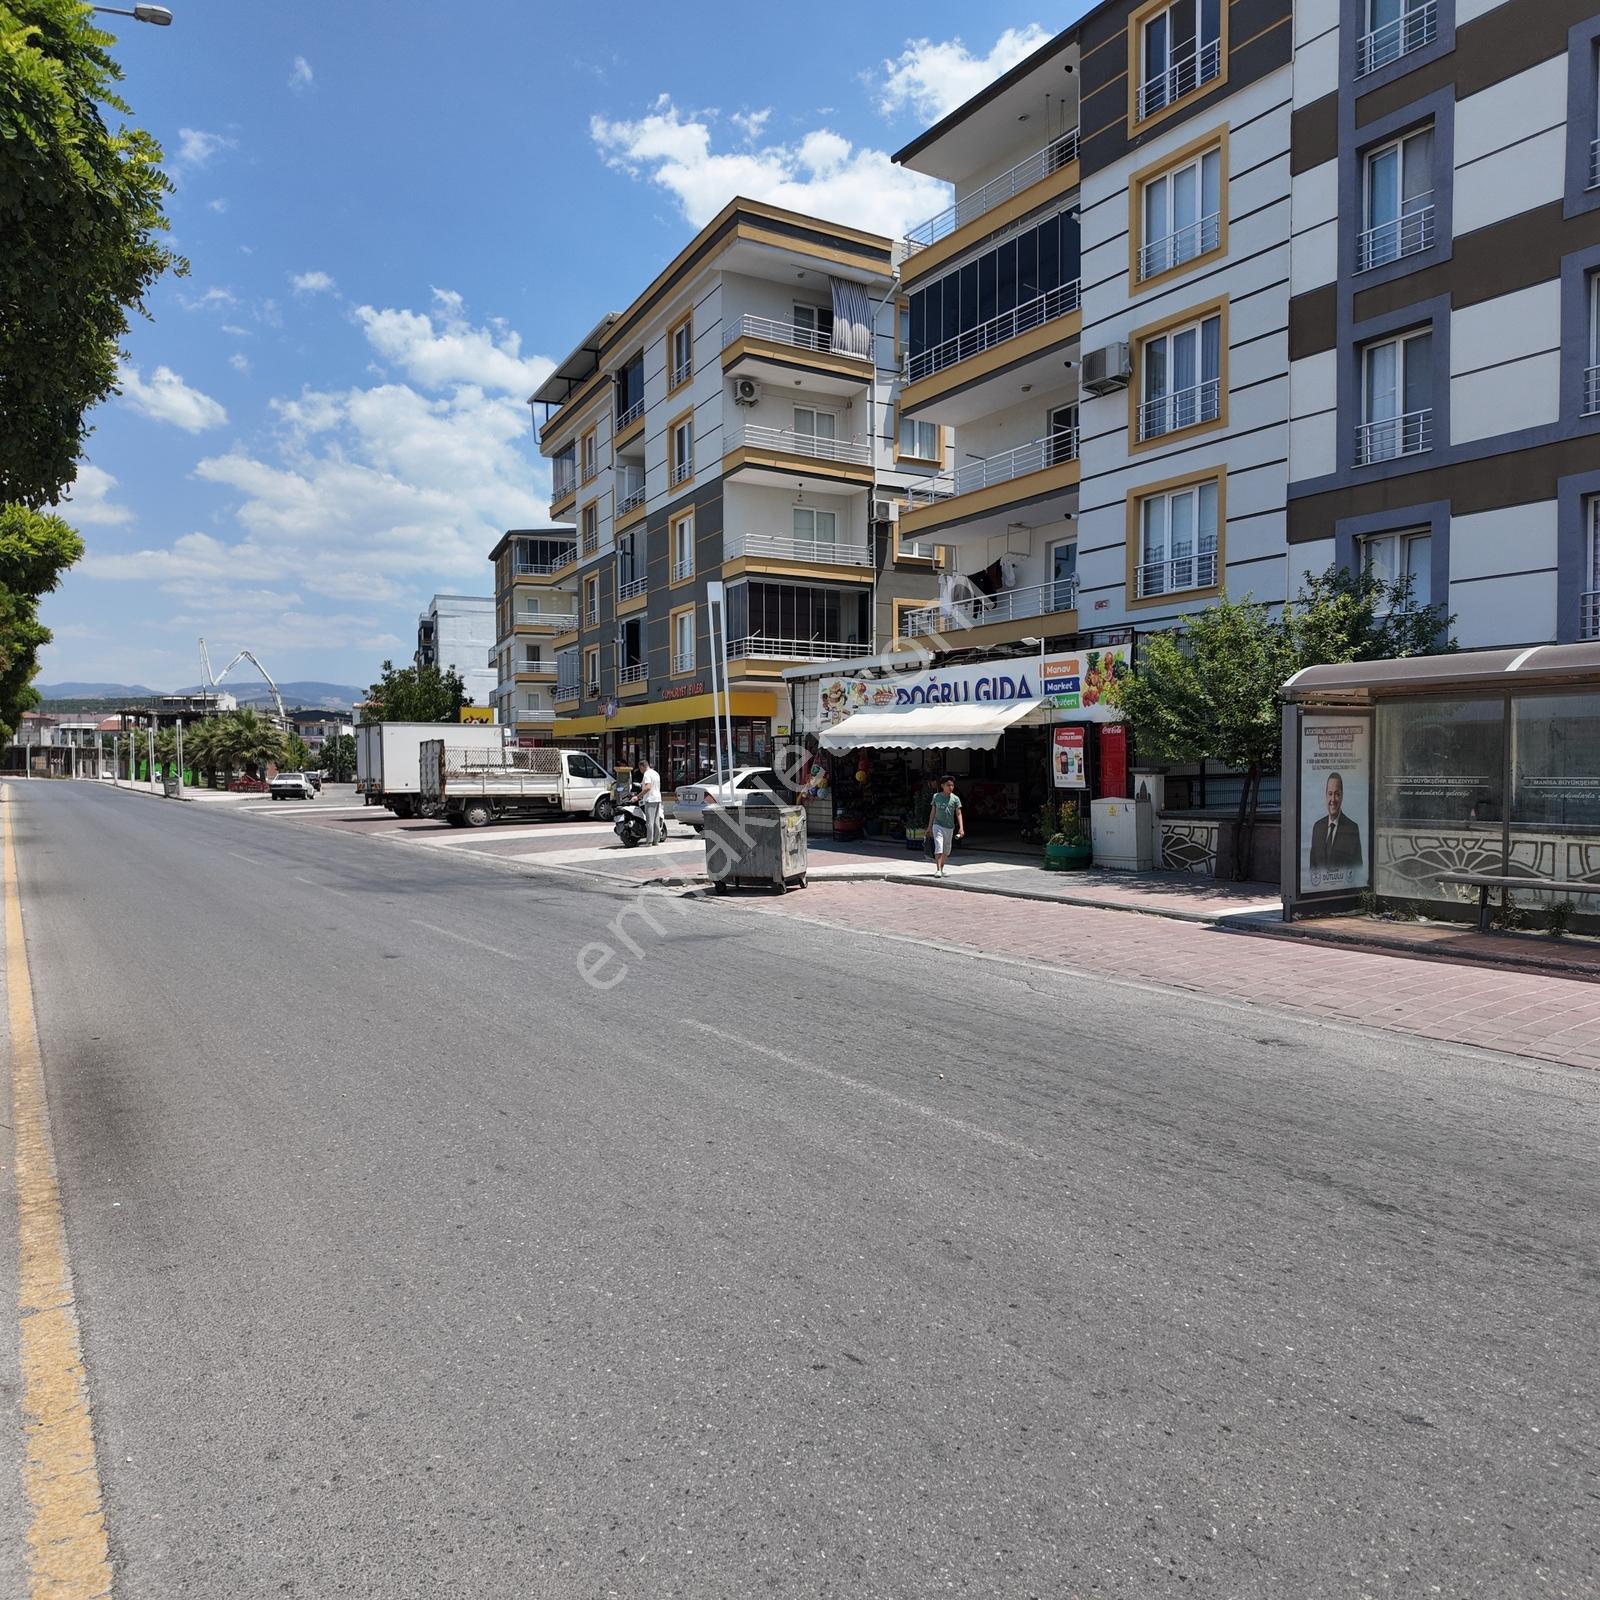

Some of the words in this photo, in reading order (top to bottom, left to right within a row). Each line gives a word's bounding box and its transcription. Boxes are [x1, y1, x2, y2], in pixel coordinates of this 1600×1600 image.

[1046, 665, 1071, 674] Manav
[896, 676, 969, 705] DOĞRU
[975, 674, 1032, 701] GIDA
[1047, 681, 1073, 691] Market
